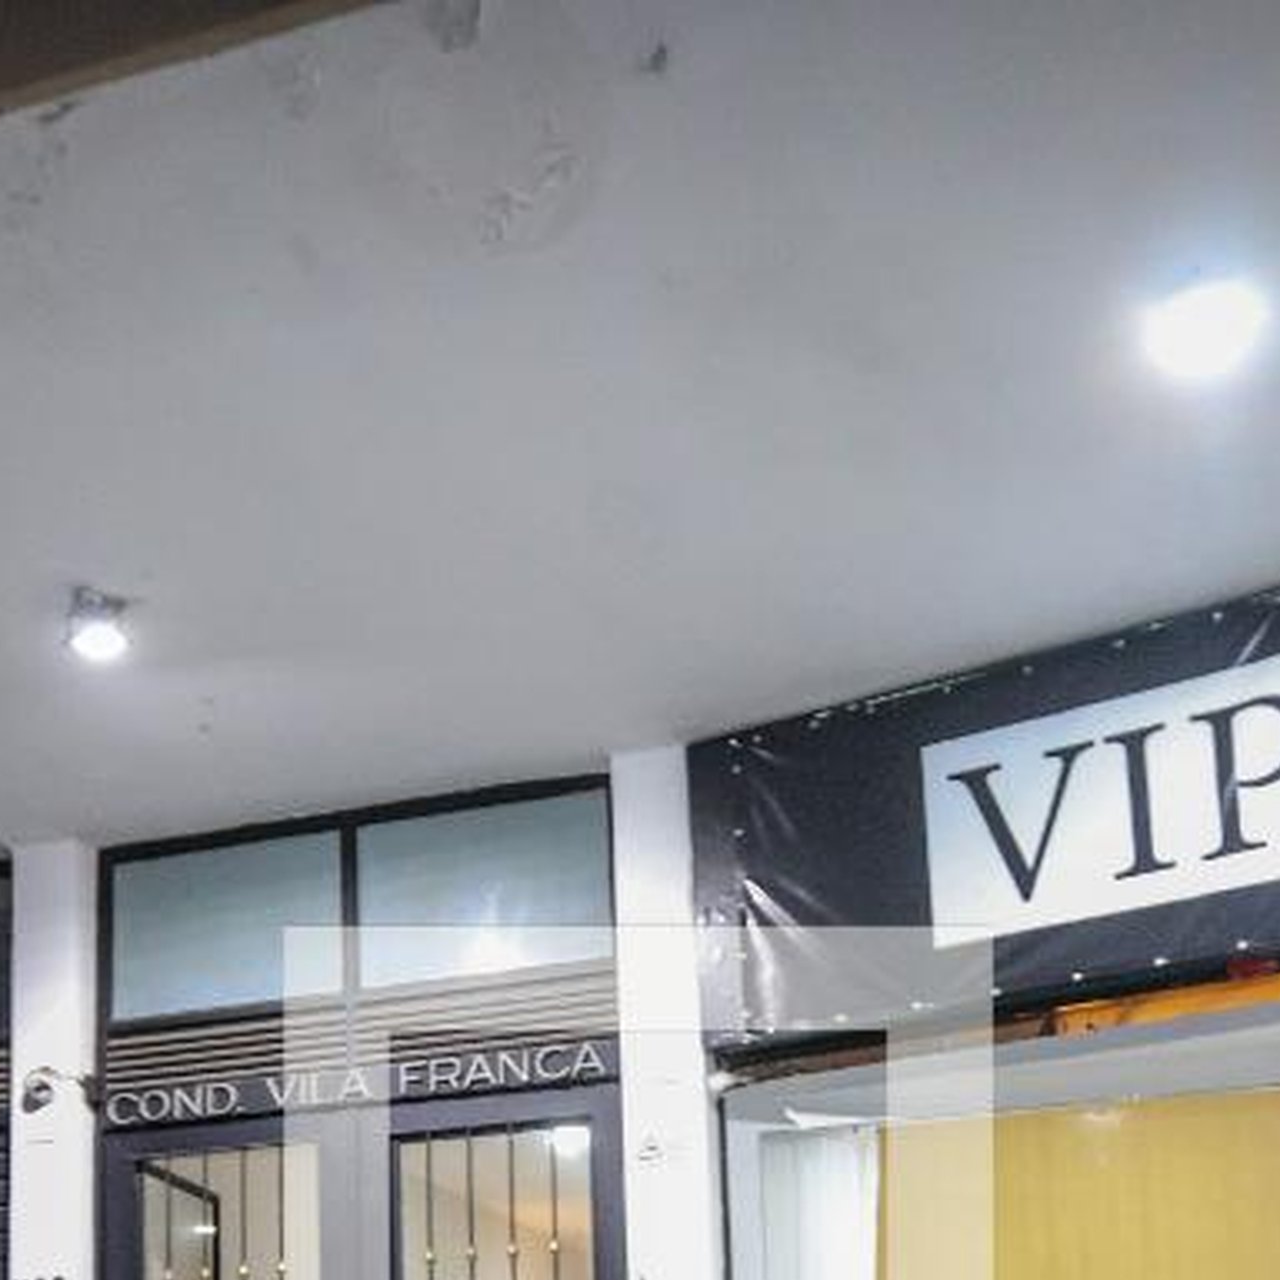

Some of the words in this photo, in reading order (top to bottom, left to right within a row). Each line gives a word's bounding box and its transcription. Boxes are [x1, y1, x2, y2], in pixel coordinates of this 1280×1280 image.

[106, 1082, 247, 1125] COND.
[265, 1067, 374, 1106] VILA
[398, 1041, 607, 1094] FRANCA
